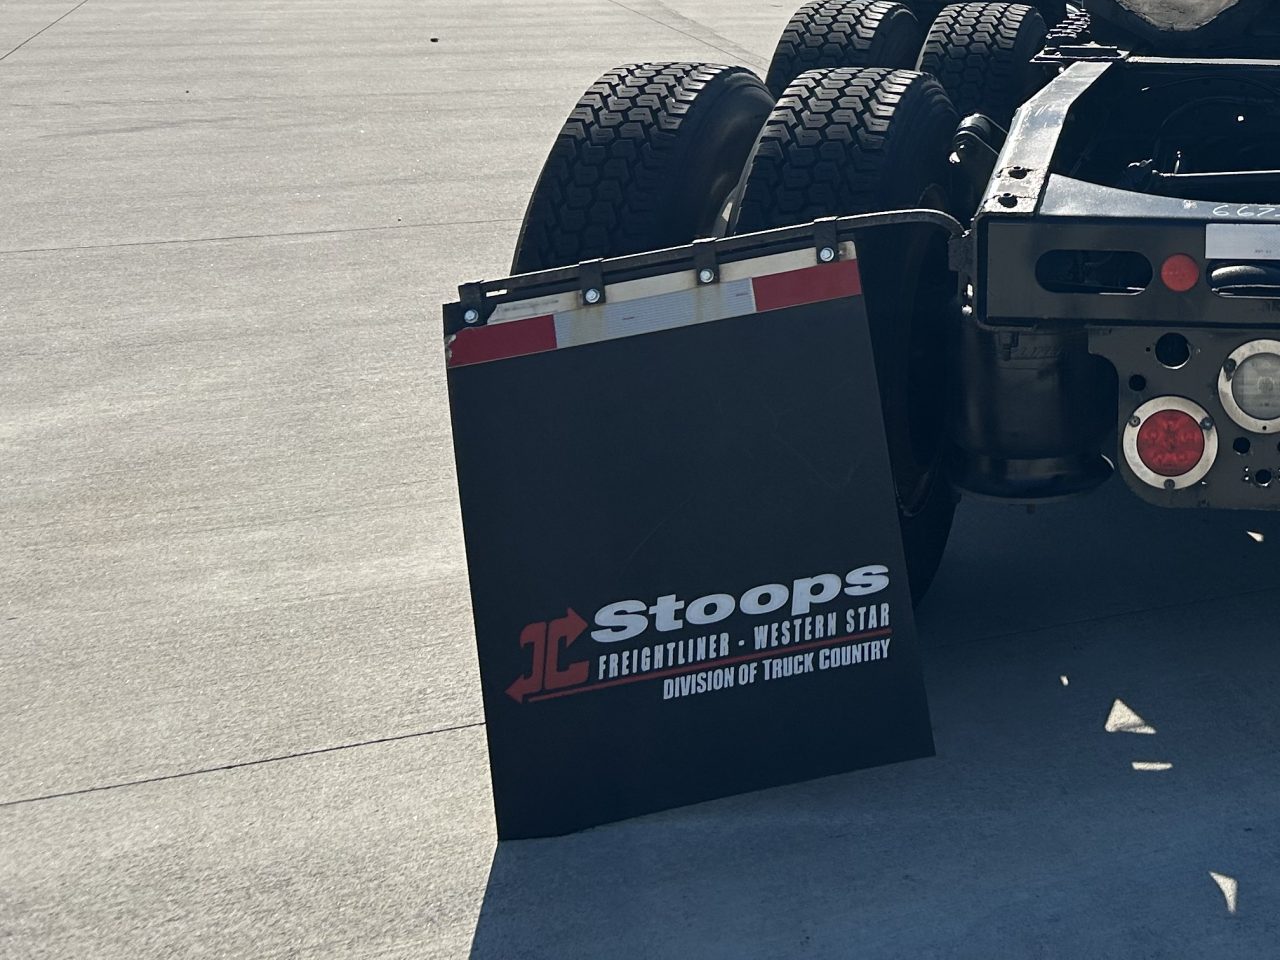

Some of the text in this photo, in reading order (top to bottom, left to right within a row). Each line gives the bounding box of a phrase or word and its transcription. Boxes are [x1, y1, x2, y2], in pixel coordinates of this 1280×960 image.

[590, 564, 890, 643] Stoops
[598, 632, 730, 680] FREIGHTLINER
[754, 612, 837, 650] WESTERN
[846, 602, 890, 633] STAR
[663, 639, 891, 700] DIVISION OF TRUCK COUNTRY
